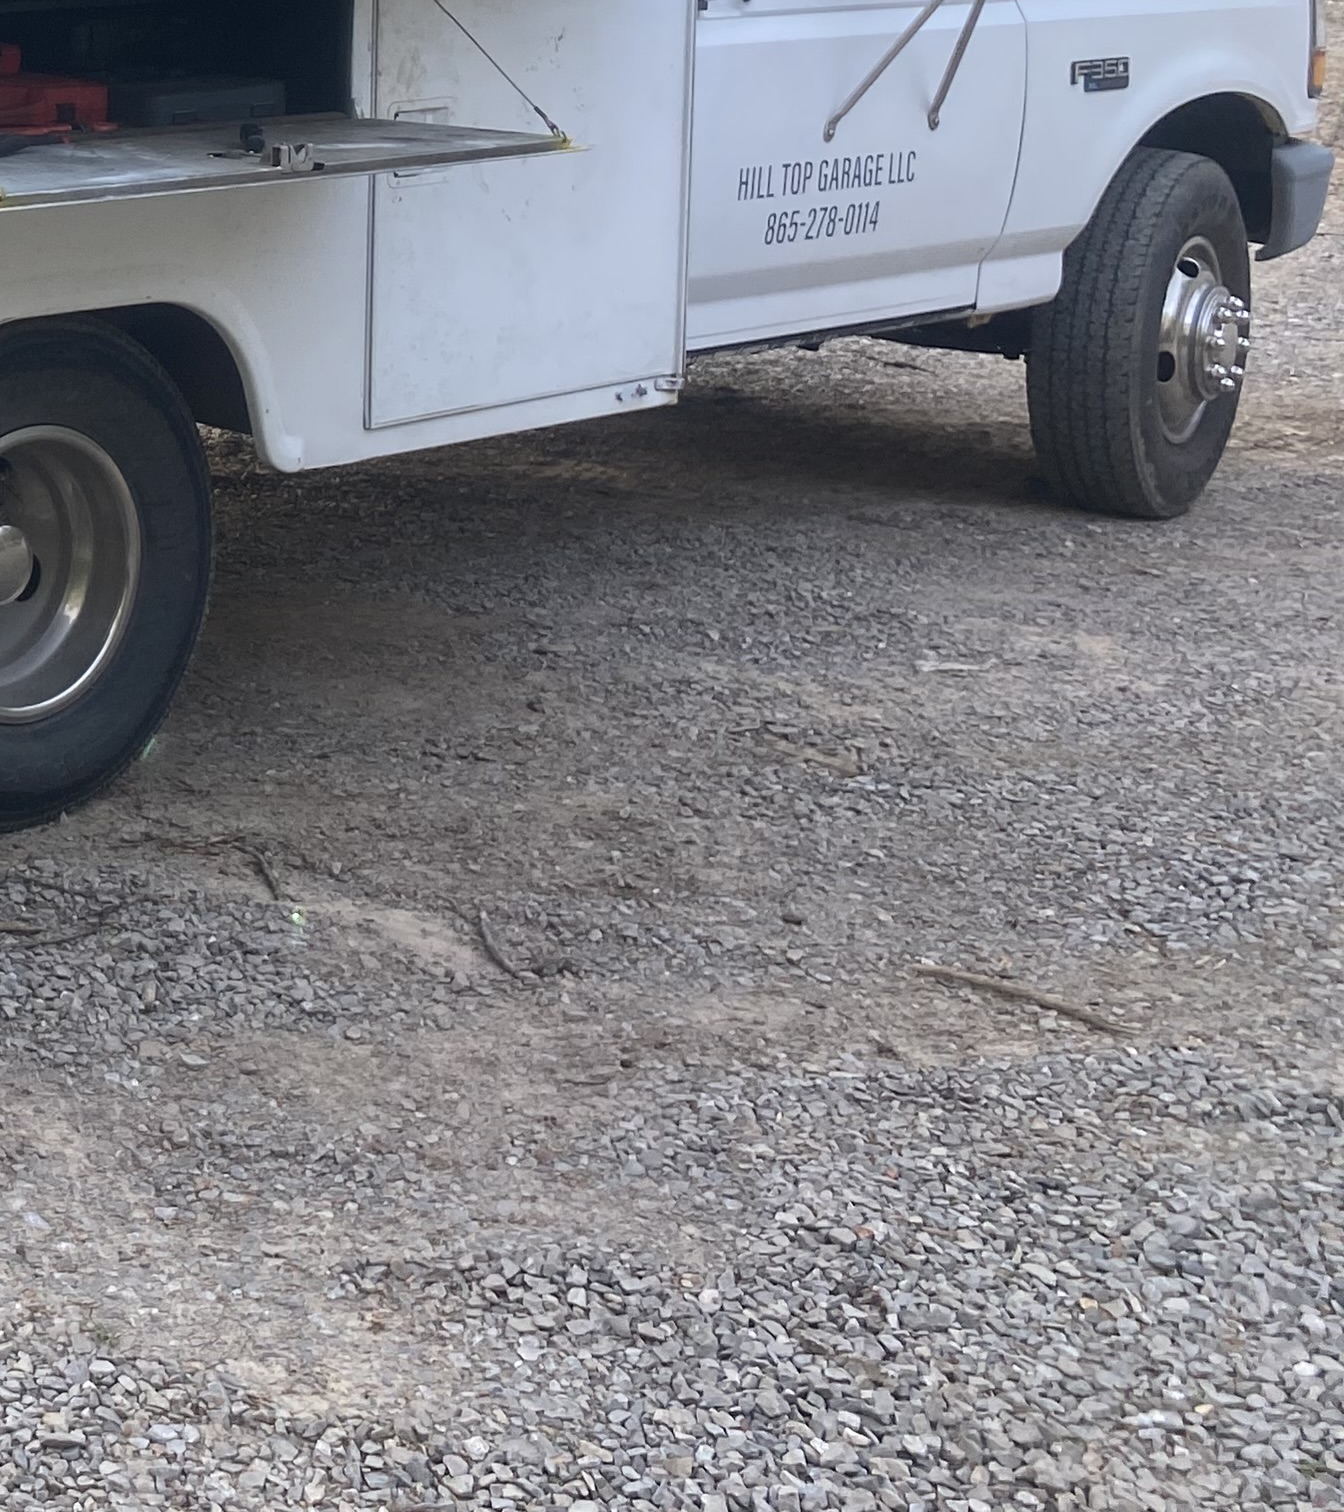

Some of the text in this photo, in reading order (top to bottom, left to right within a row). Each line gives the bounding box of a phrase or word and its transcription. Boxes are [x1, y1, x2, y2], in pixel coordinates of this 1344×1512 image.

[1074, 58, 1129, 80] F350
[737, 150, 917, 201] HILL TOP GARAGE LLC
[764, 200, 881, 246] 865-278-0114
